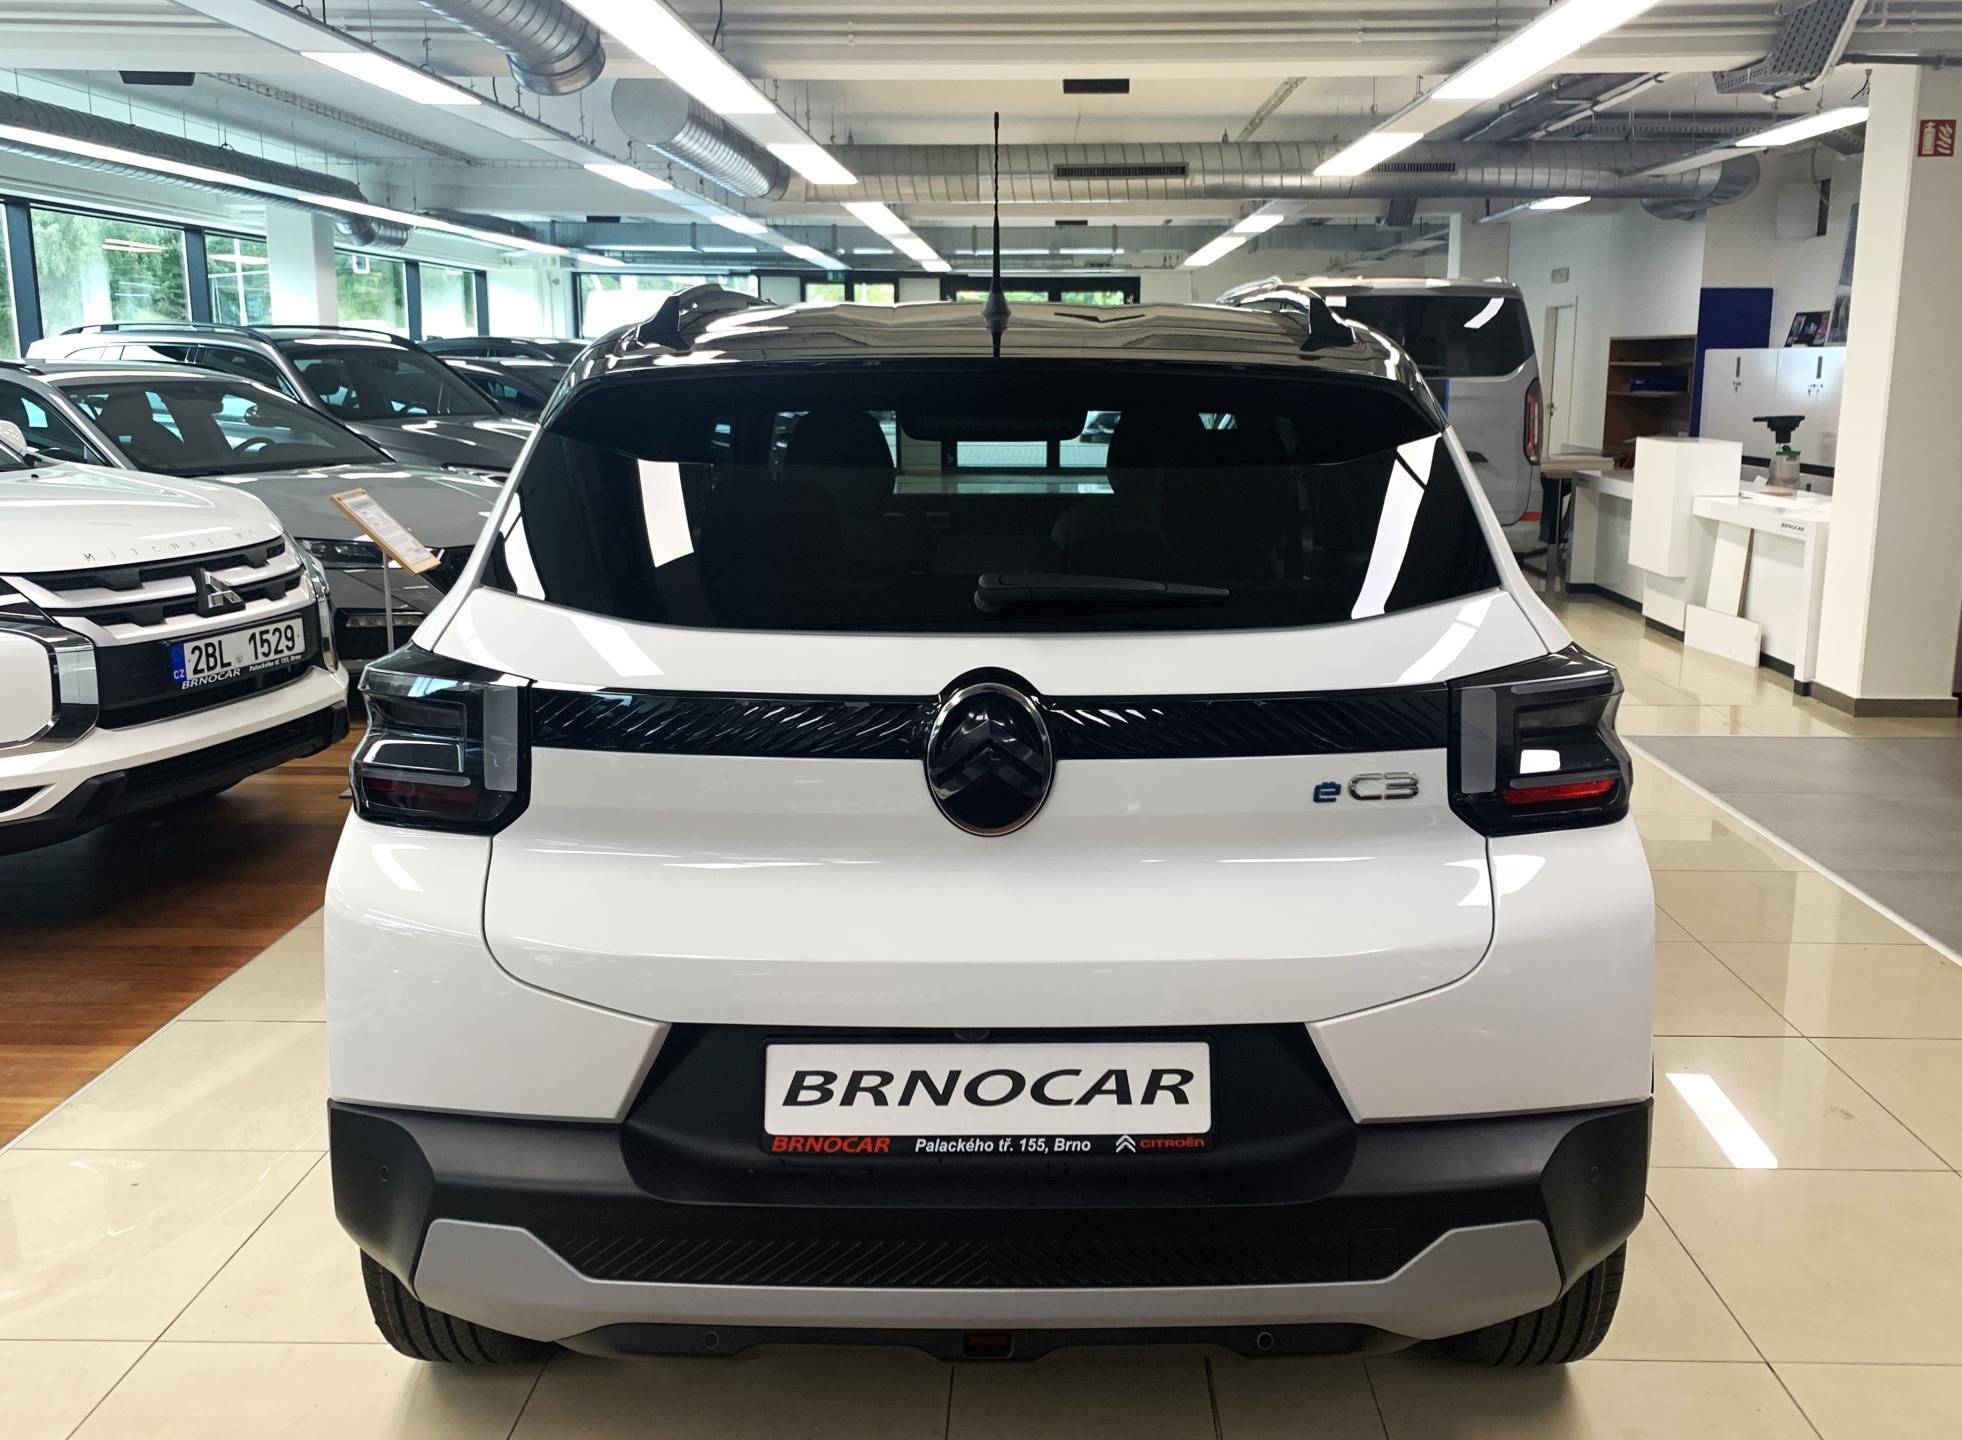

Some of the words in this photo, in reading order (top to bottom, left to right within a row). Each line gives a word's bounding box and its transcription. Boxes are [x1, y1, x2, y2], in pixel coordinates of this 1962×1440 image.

[190, 640, 232, 676] 2BL
[248, 624, 296, 661] 1529
[173, 669, 185, 680] CZ
[181, 668, 241, 690] BRNOCAR
[782, 1068, 1194, 1107] BRNOCAR
[772, 1136, 891, 1153] BRNOCAR
[915, 1137, 994, 1153] Palackého
[998, 1137, 1014, 1152] tř.
[1019, 1138, 1049, 1154] 155,
[1053, 1137, 1091, 1152] Brno
